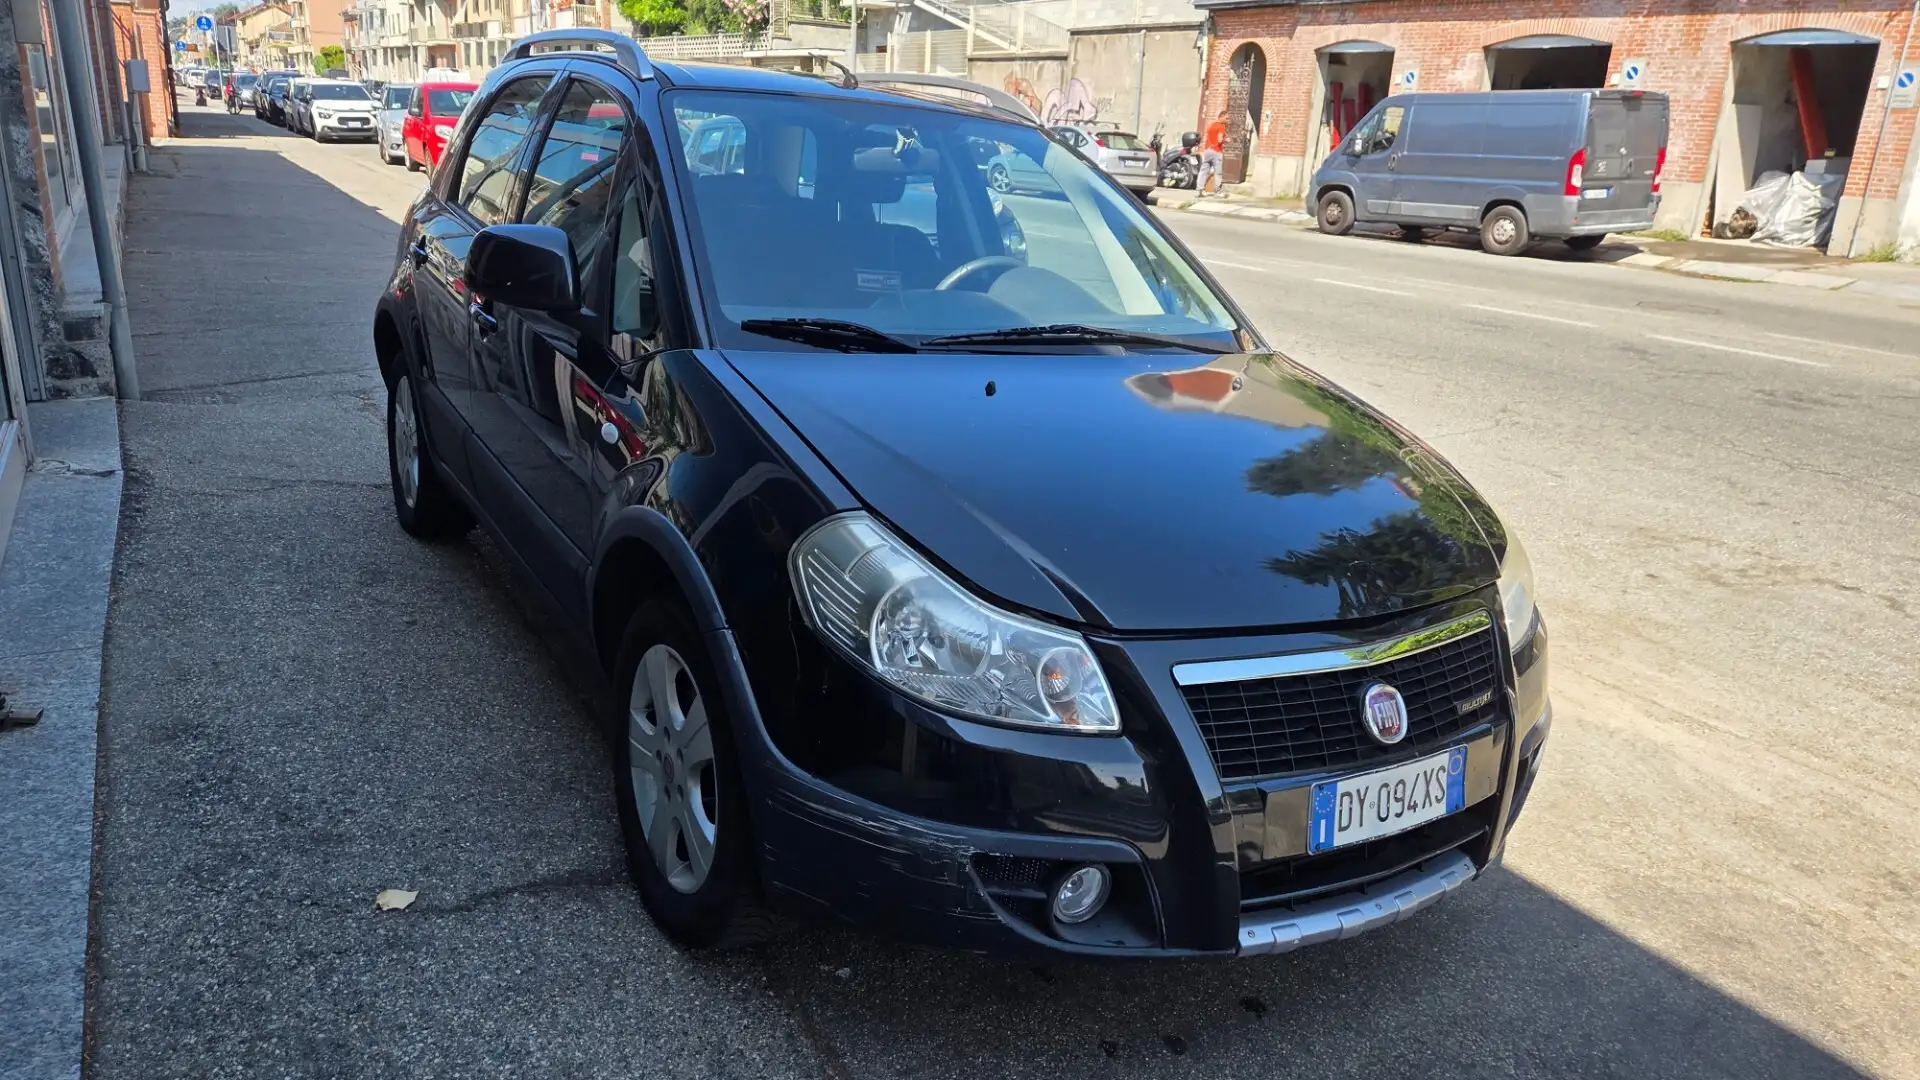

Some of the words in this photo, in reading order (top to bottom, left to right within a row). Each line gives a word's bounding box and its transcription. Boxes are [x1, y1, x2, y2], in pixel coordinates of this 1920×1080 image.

[1374, 700, 1399, 729] FIAT
[1338, 785, 1369, 832] DY
[1377, 765, 1446, 822] 094XS
